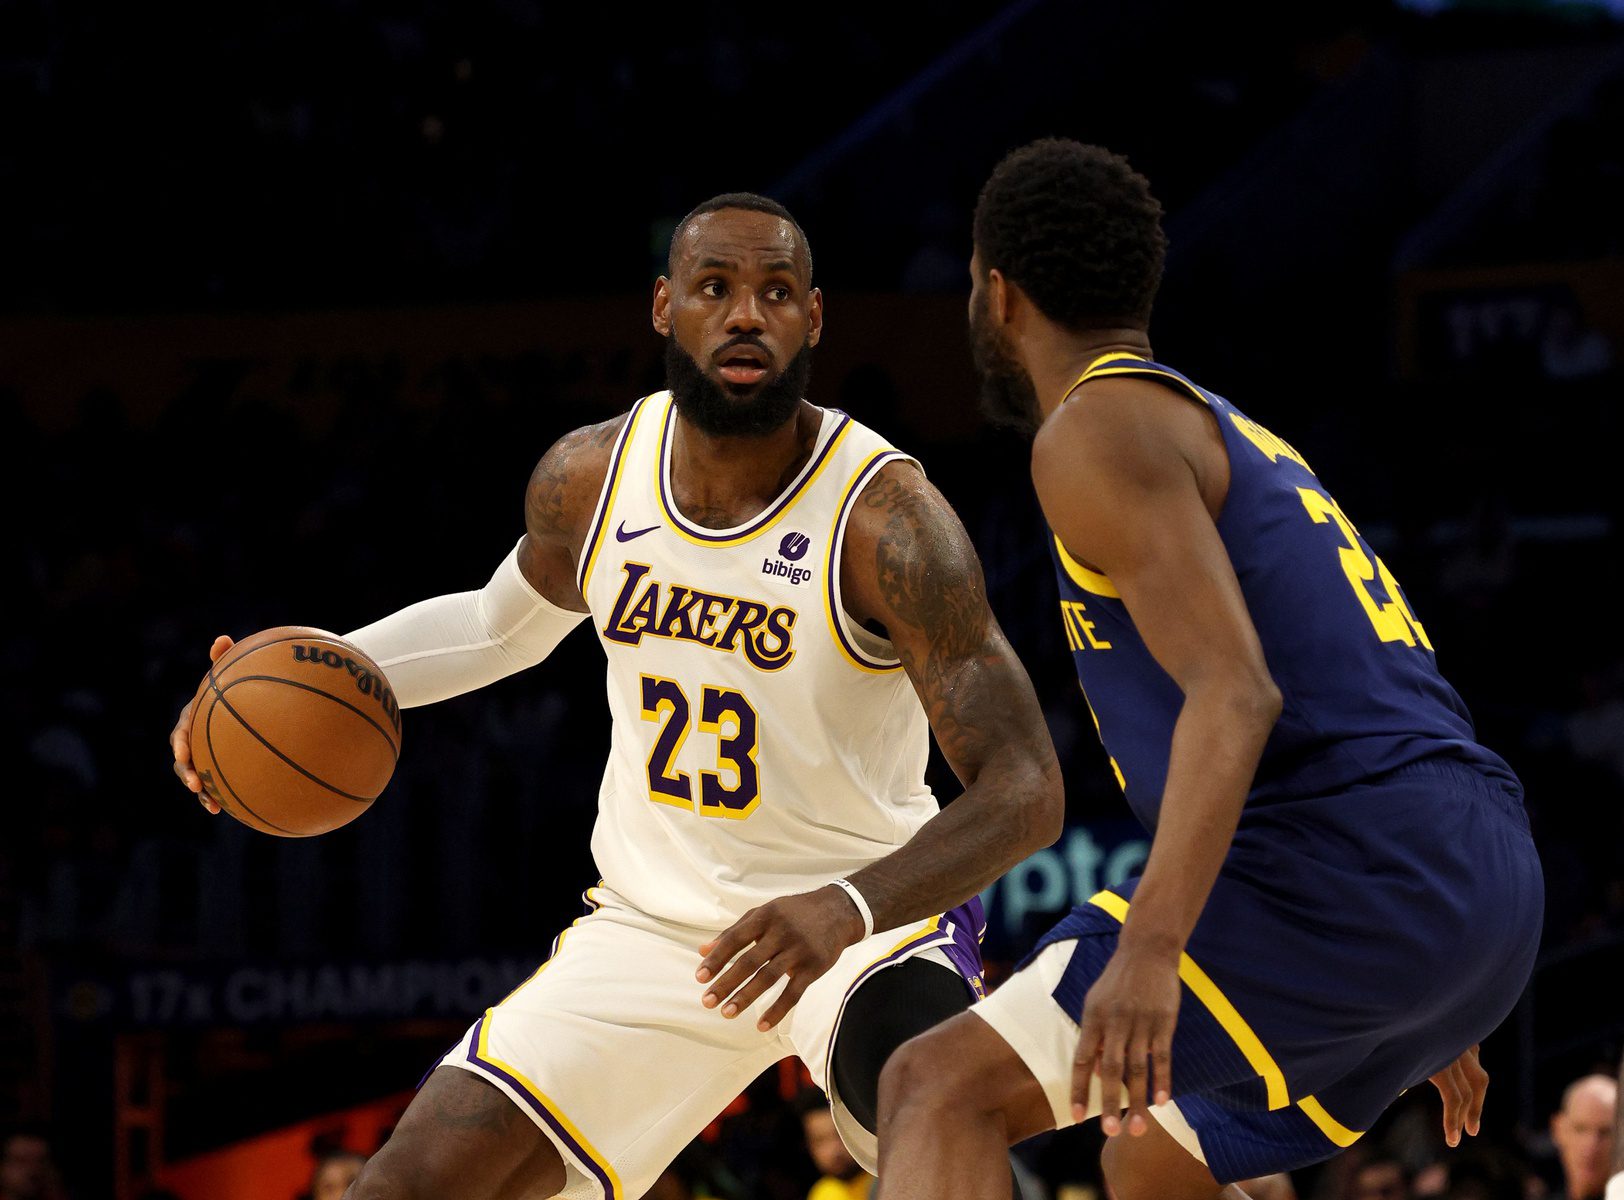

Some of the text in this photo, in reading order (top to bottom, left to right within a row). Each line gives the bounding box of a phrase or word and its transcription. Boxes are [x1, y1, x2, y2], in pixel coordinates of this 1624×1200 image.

[603, 560, 799, 673] LAKERS
[762, 558, 812, 585] bibigo
[639, 672, 761, 820] 23
